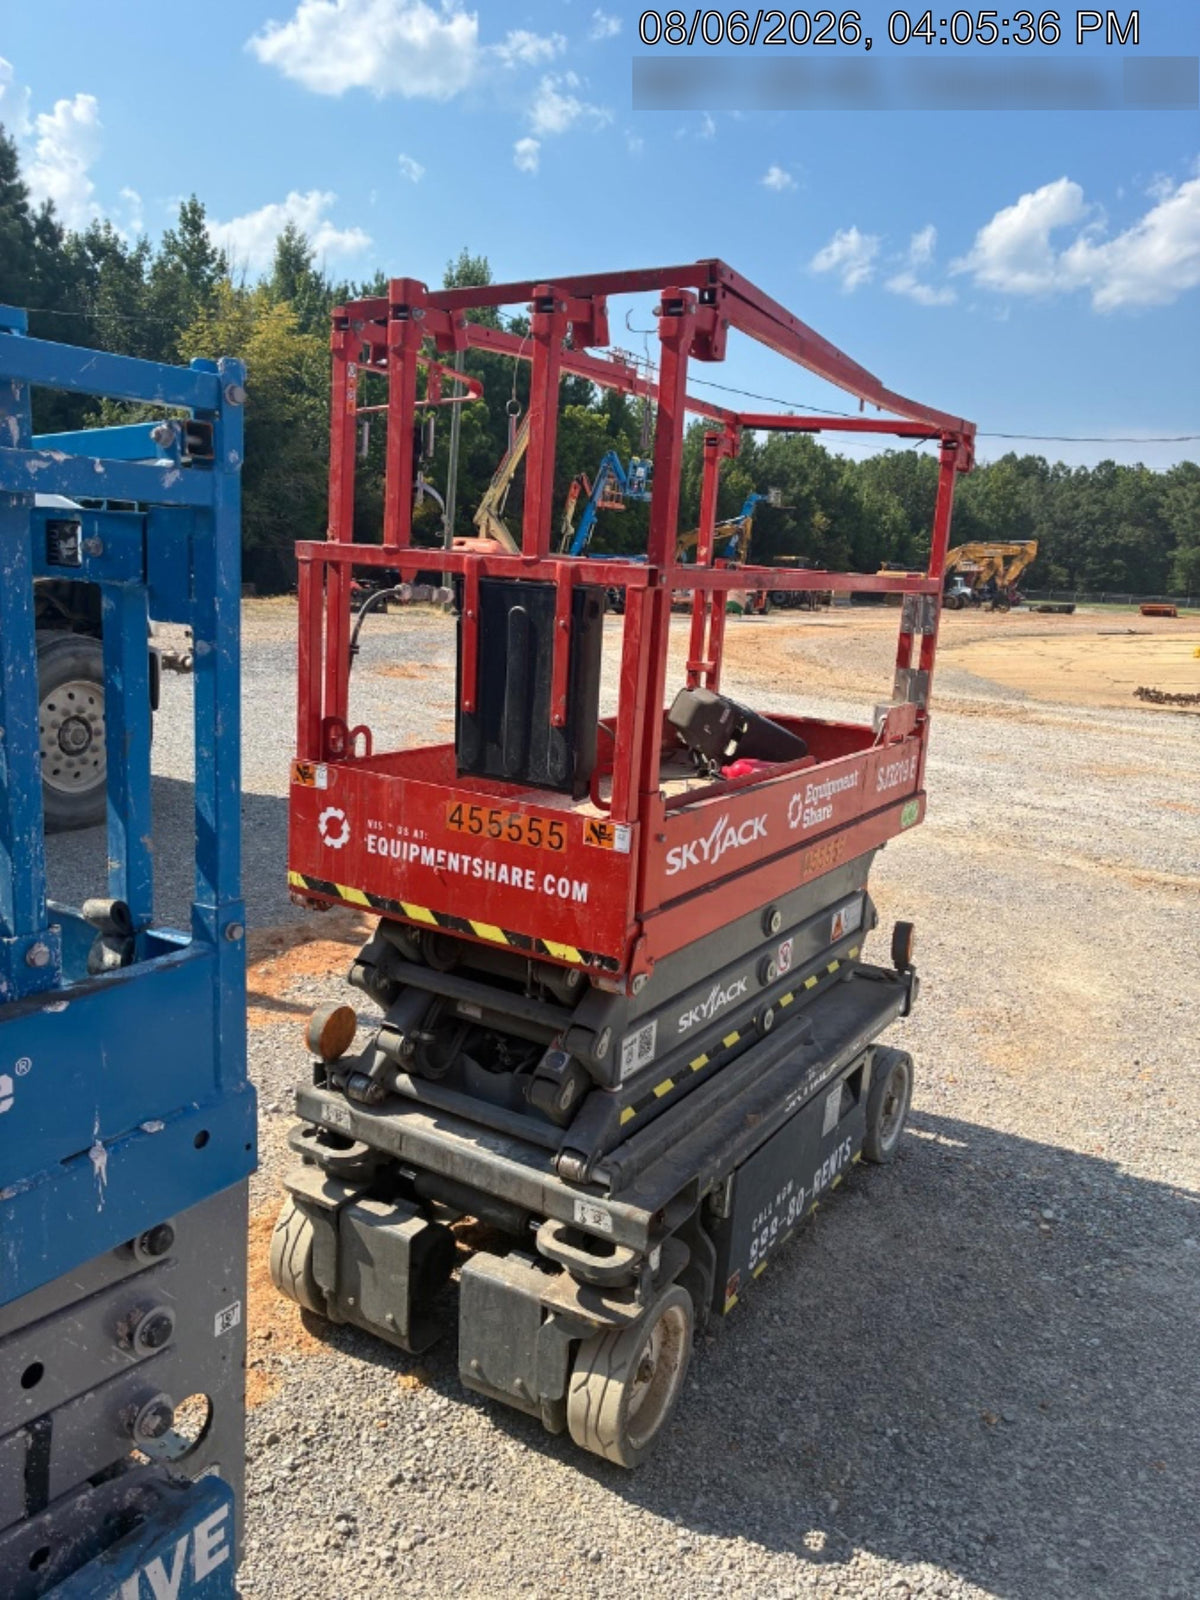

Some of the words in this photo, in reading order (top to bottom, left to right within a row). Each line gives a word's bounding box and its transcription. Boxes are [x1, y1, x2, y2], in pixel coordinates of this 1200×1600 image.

[804, 769, 858, 806] Equipment
[449, 803, 564, 851] 455555
[802, 804, 833, 829] Share
[665, 812, 769, 876] SKYJACK
[678, 975, 748, 1033] SKYJACK
